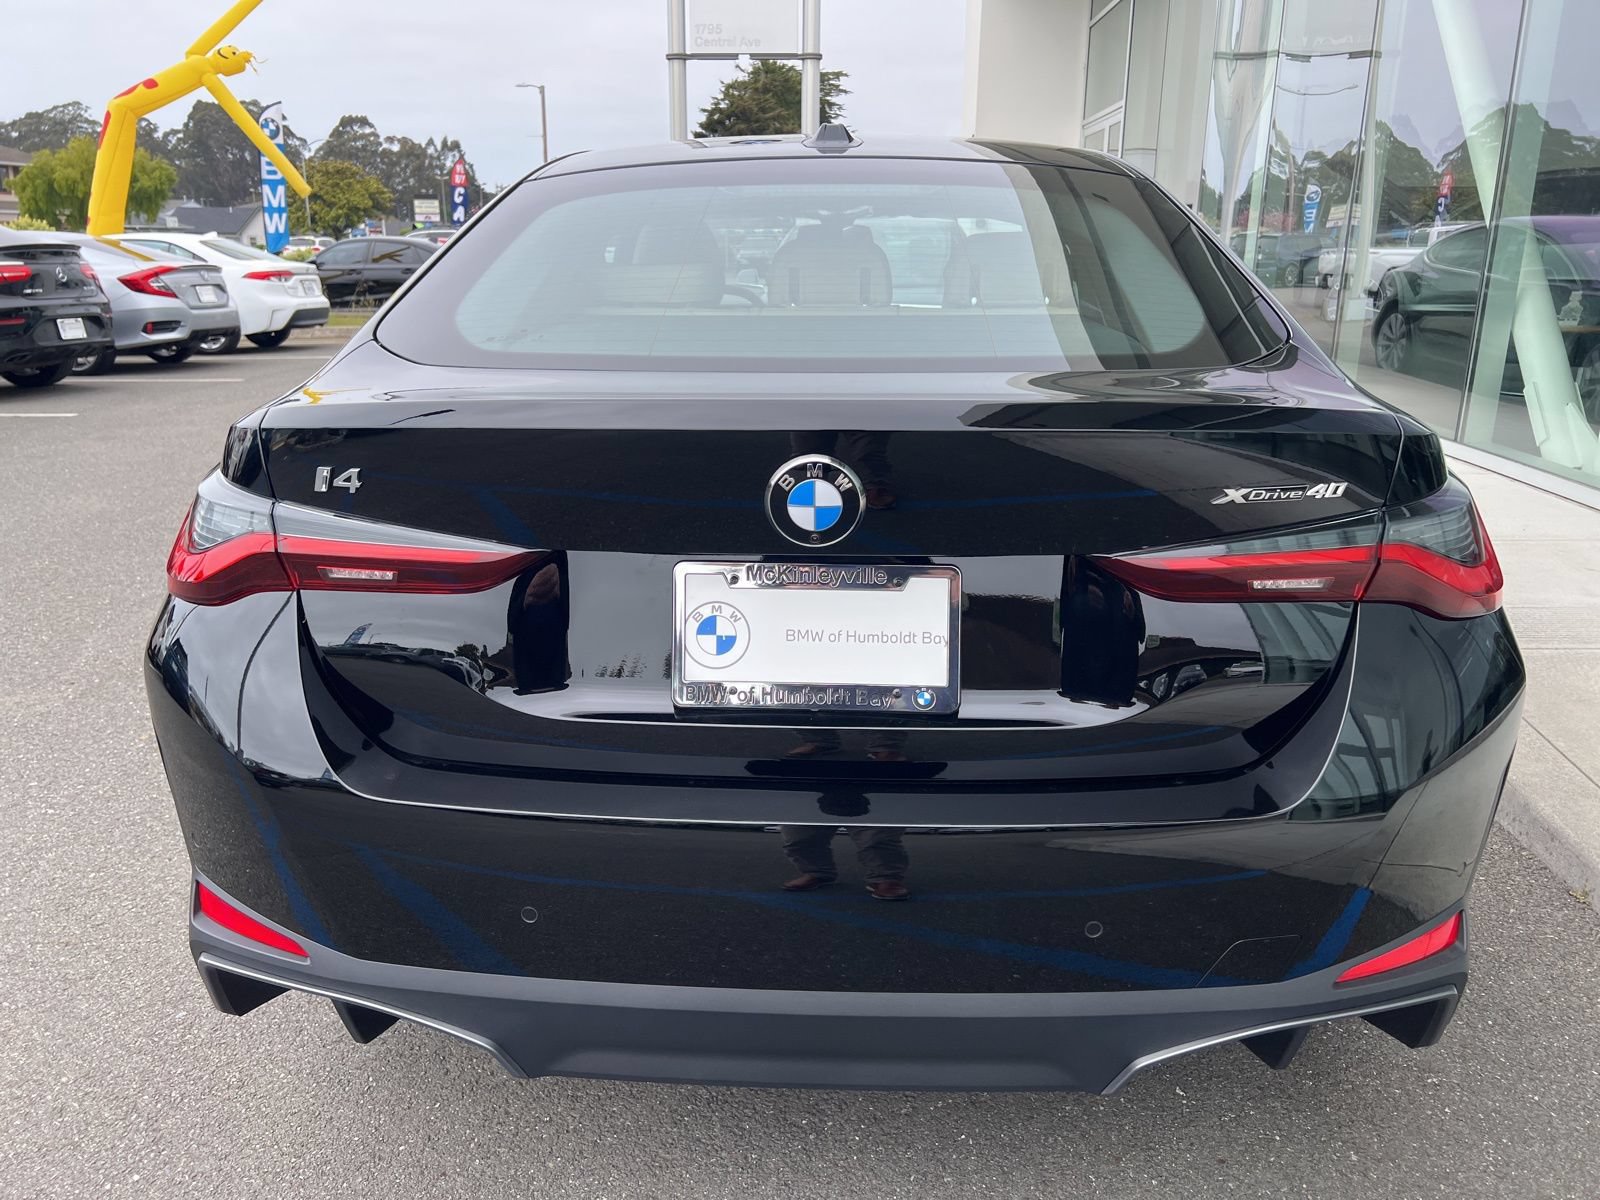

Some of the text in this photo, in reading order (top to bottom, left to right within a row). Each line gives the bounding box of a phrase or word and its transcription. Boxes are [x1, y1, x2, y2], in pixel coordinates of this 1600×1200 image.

[694, 36, 761, 48] Central Ave
[314, 466, 363, 494] i4
[778, 463, 853, 493] BMW
[746, 564, 888, 588] McKinleyville
[692, 604, 742, 624] BMW
[785, 629, 949, 648] BMW of Humboldt Bay
[685, 685, 728, 703] BMW
[737, 686, 756, 704] of
[760, 687, 851, 706] Humboldt
[856, 689, 894, 709] Bay
